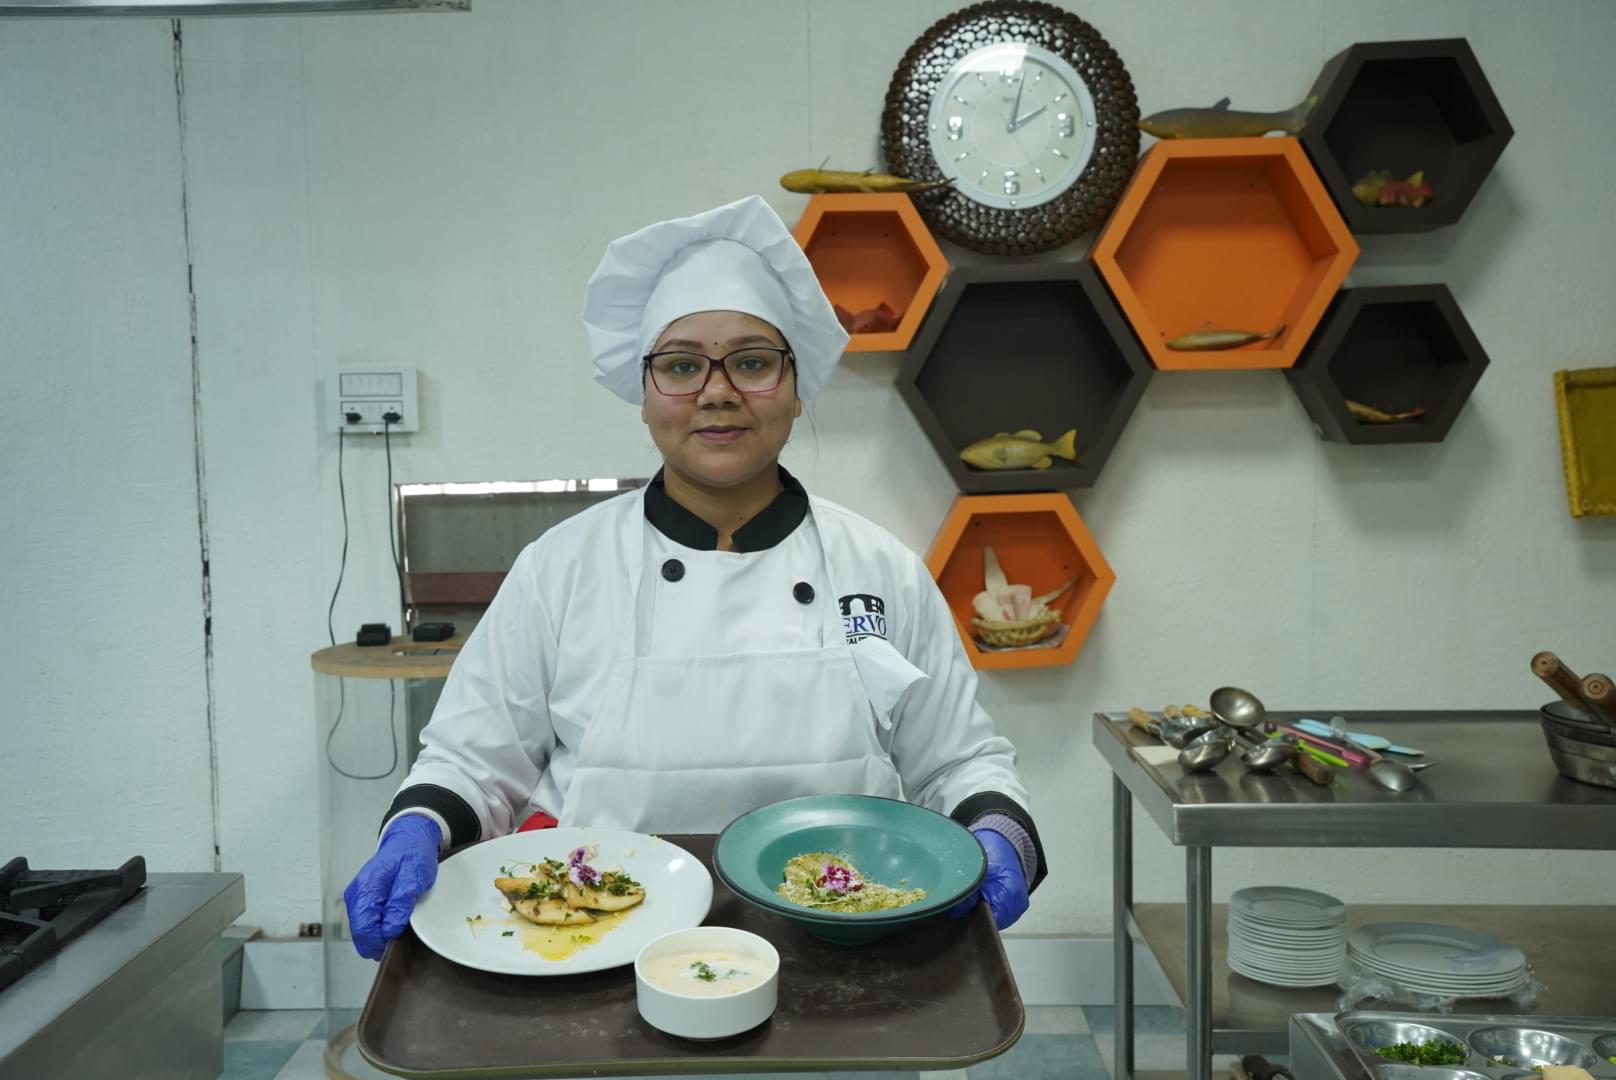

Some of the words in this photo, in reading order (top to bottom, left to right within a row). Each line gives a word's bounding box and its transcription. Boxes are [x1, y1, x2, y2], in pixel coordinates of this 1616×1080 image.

[947, 116, 963, 140] 9
[1057, 113, 1074, 138] 3
[1004, 171, 1020, 195] 6
